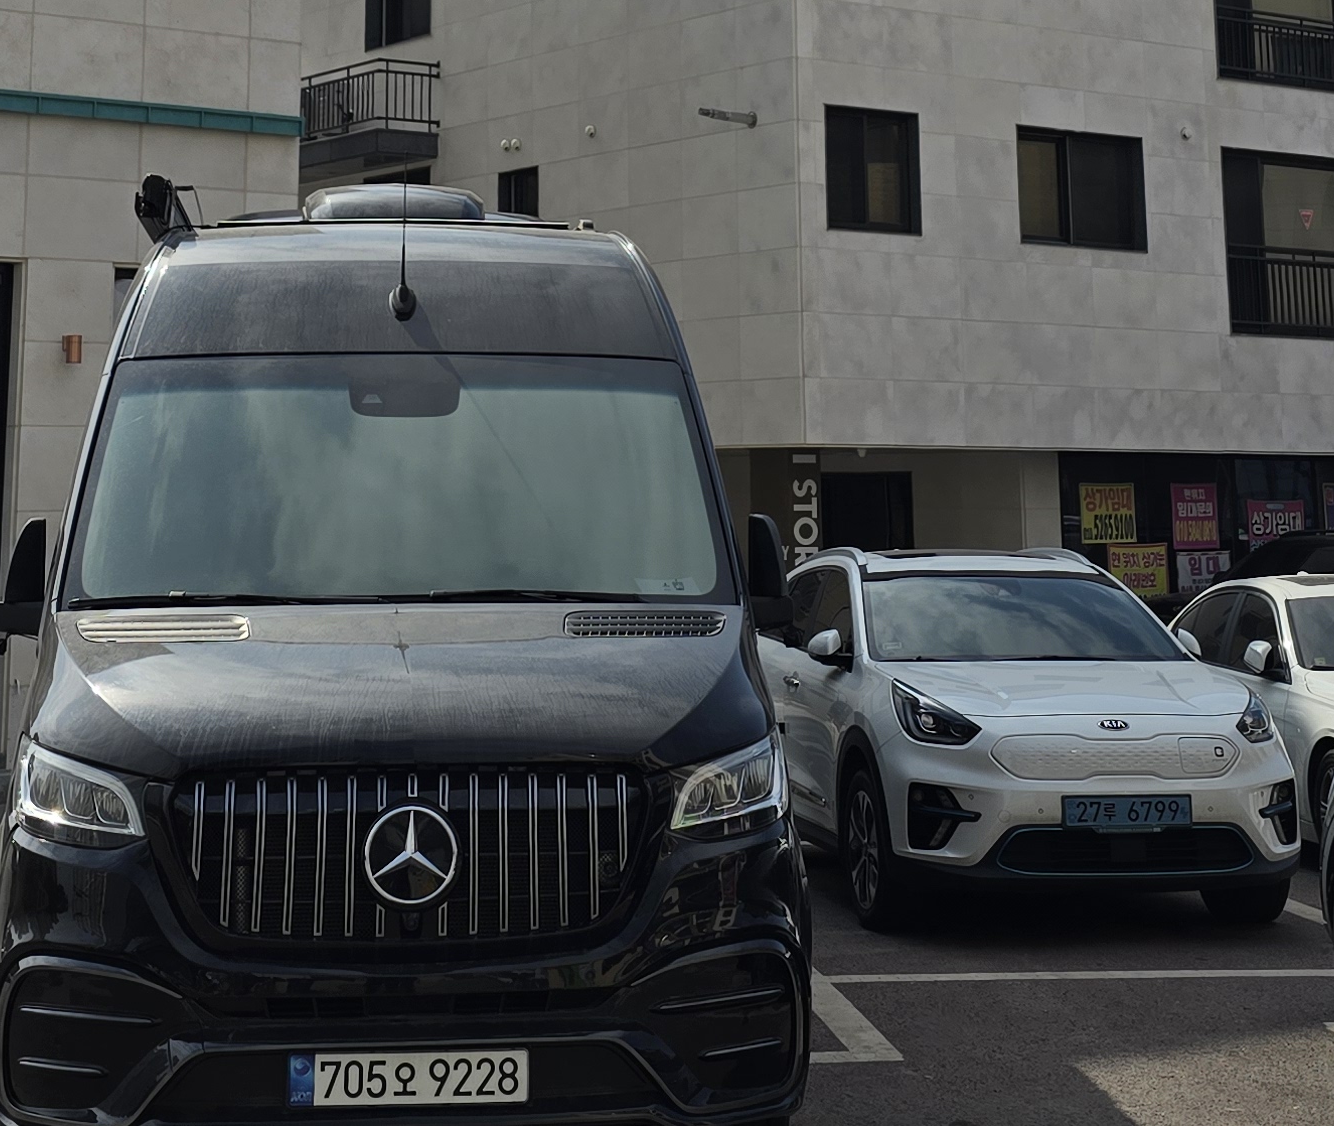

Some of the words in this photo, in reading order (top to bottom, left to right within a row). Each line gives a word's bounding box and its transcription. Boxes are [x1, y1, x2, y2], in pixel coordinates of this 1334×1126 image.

[1084, 488, 1132, 511] 상가임대
[1177, 502, 1213, 517] 임대문의
[1252, 511, 1301, 535] 상가임대
[1076, 802, 1116, 822] 27루
[1127, 801, 1179, 822] 6799
[320, 1060, 417, 1099] 705오
[429, 1057, 519, 1097] 9228
